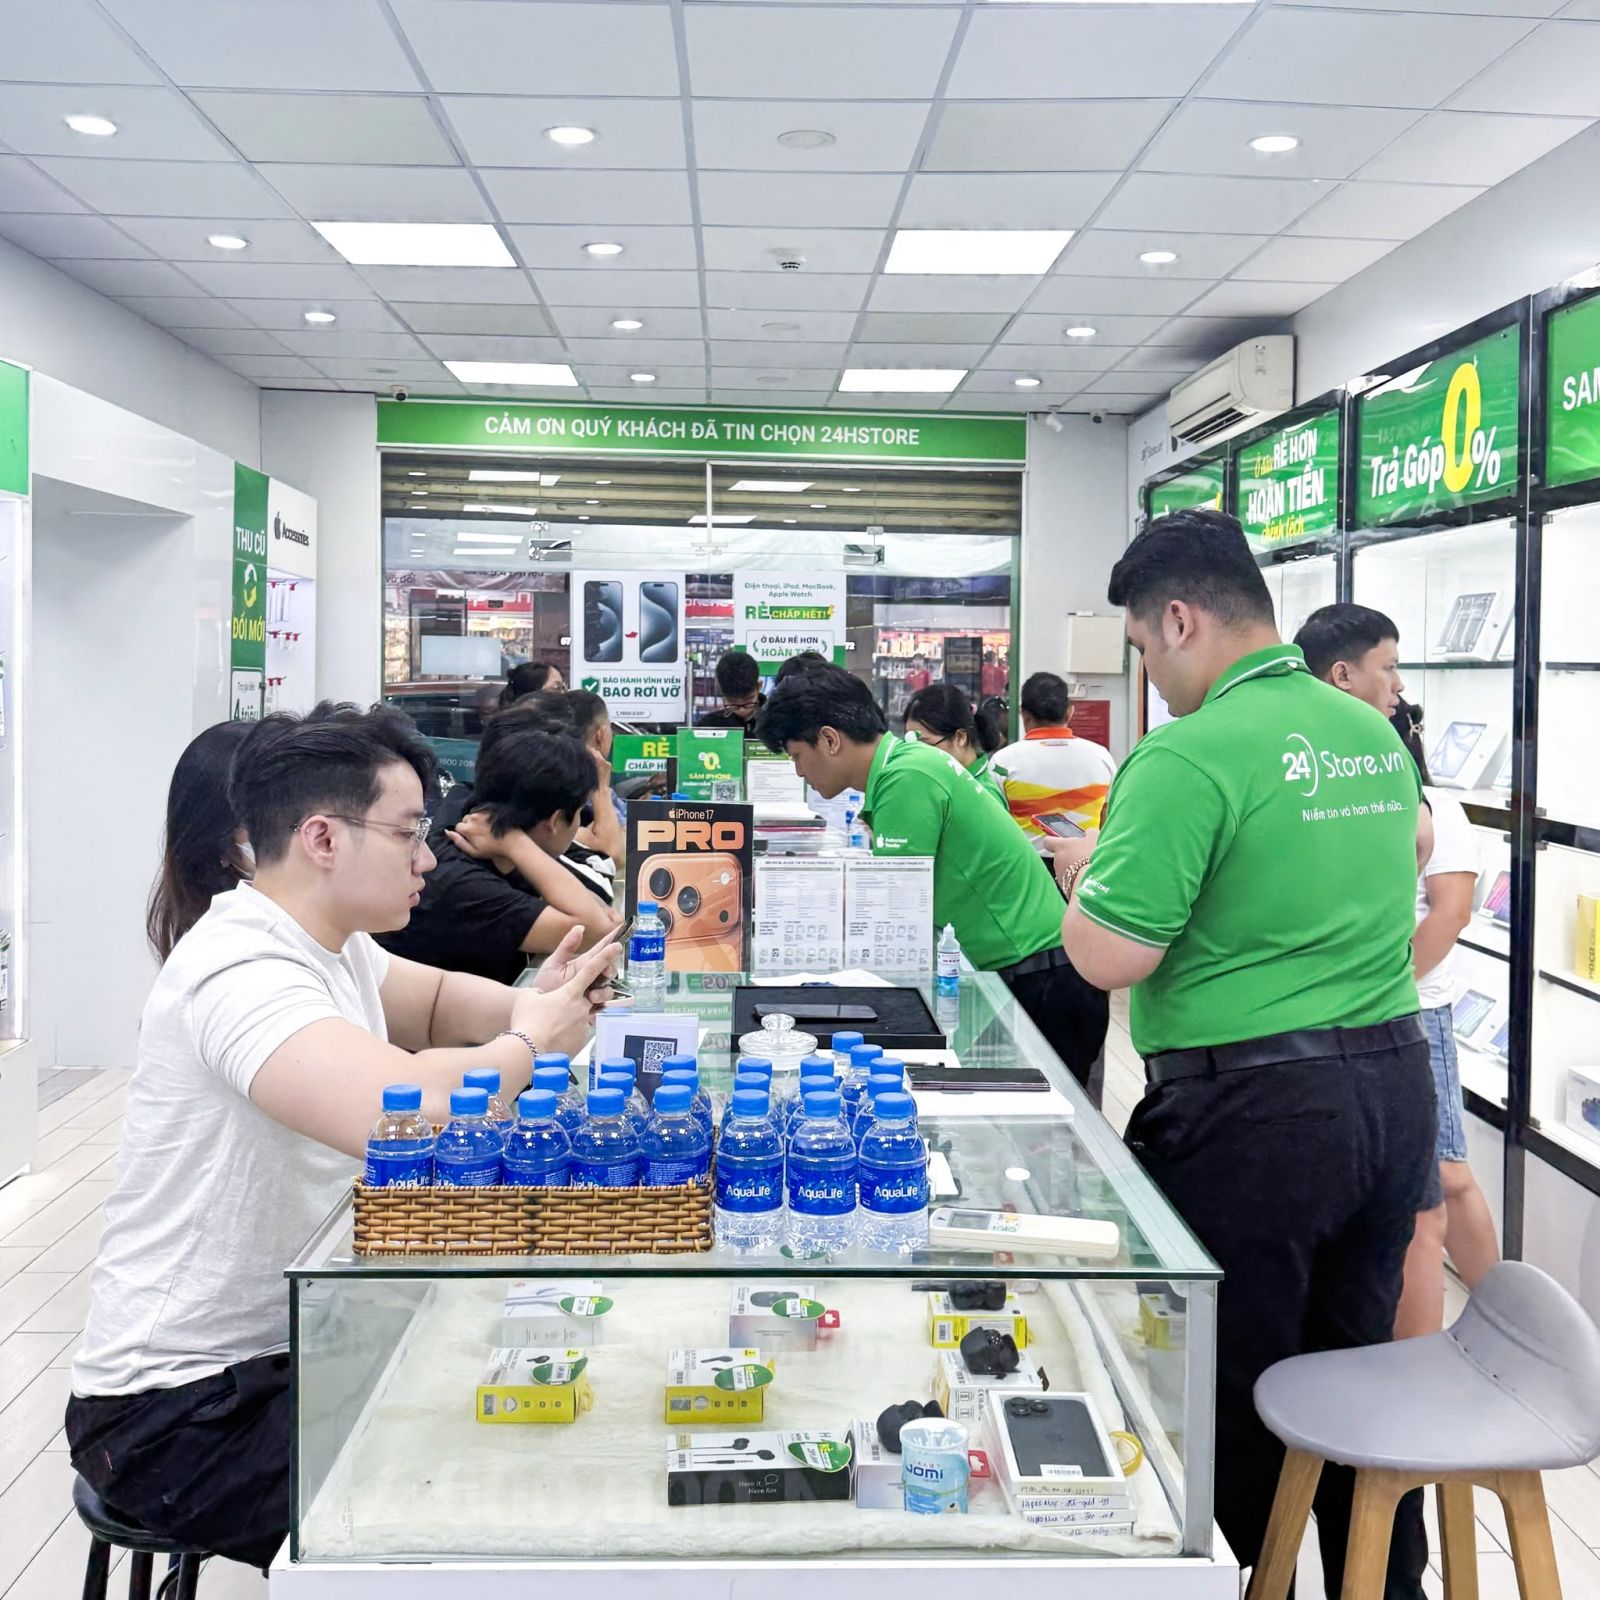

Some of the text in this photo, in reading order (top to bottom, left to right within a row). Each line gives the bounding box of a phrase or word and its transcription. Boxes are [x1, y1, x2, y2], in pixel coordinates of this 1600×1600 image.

[484, 411, 920, 446] CẢM ƠN QUÝ KHÁCH ĐÃ TIN CHỌN 24HSTORE
[1370, 362, 1501, 498] Trả Góp 0%
[1273, 431, 1288, 470] RẺ
[1289, 428, 1318, 465] HƠN
[1247, 459, 1325, 526] HOÀN TIỀN
[235, 526, 266, 557] THU CŨ
[745, 601, 770, 620] RẺ
[771, 609, 801, 619] CHẤP
[249, 615, 265, 642] MỚI
[768, 636, 786, 644] ĐÂU
[602, 684, 681, 698] BAO RƠI VỠ
[642, 736, 670, 758] RẺ
[628, 759, 655, 770] CHẤP
[1320, 751, 1405, 779] Store.vn
[675, 808, 715, 820] iPhone 17
[1326, 806, 1339, 820] tin
[637, 820, 745, 851] PRO
[726, 1184, 771, 1198] AquaLife
[798, 1185, 843, 1200] AquaLife
[874, 1185, 918, 1200] AquaLife
